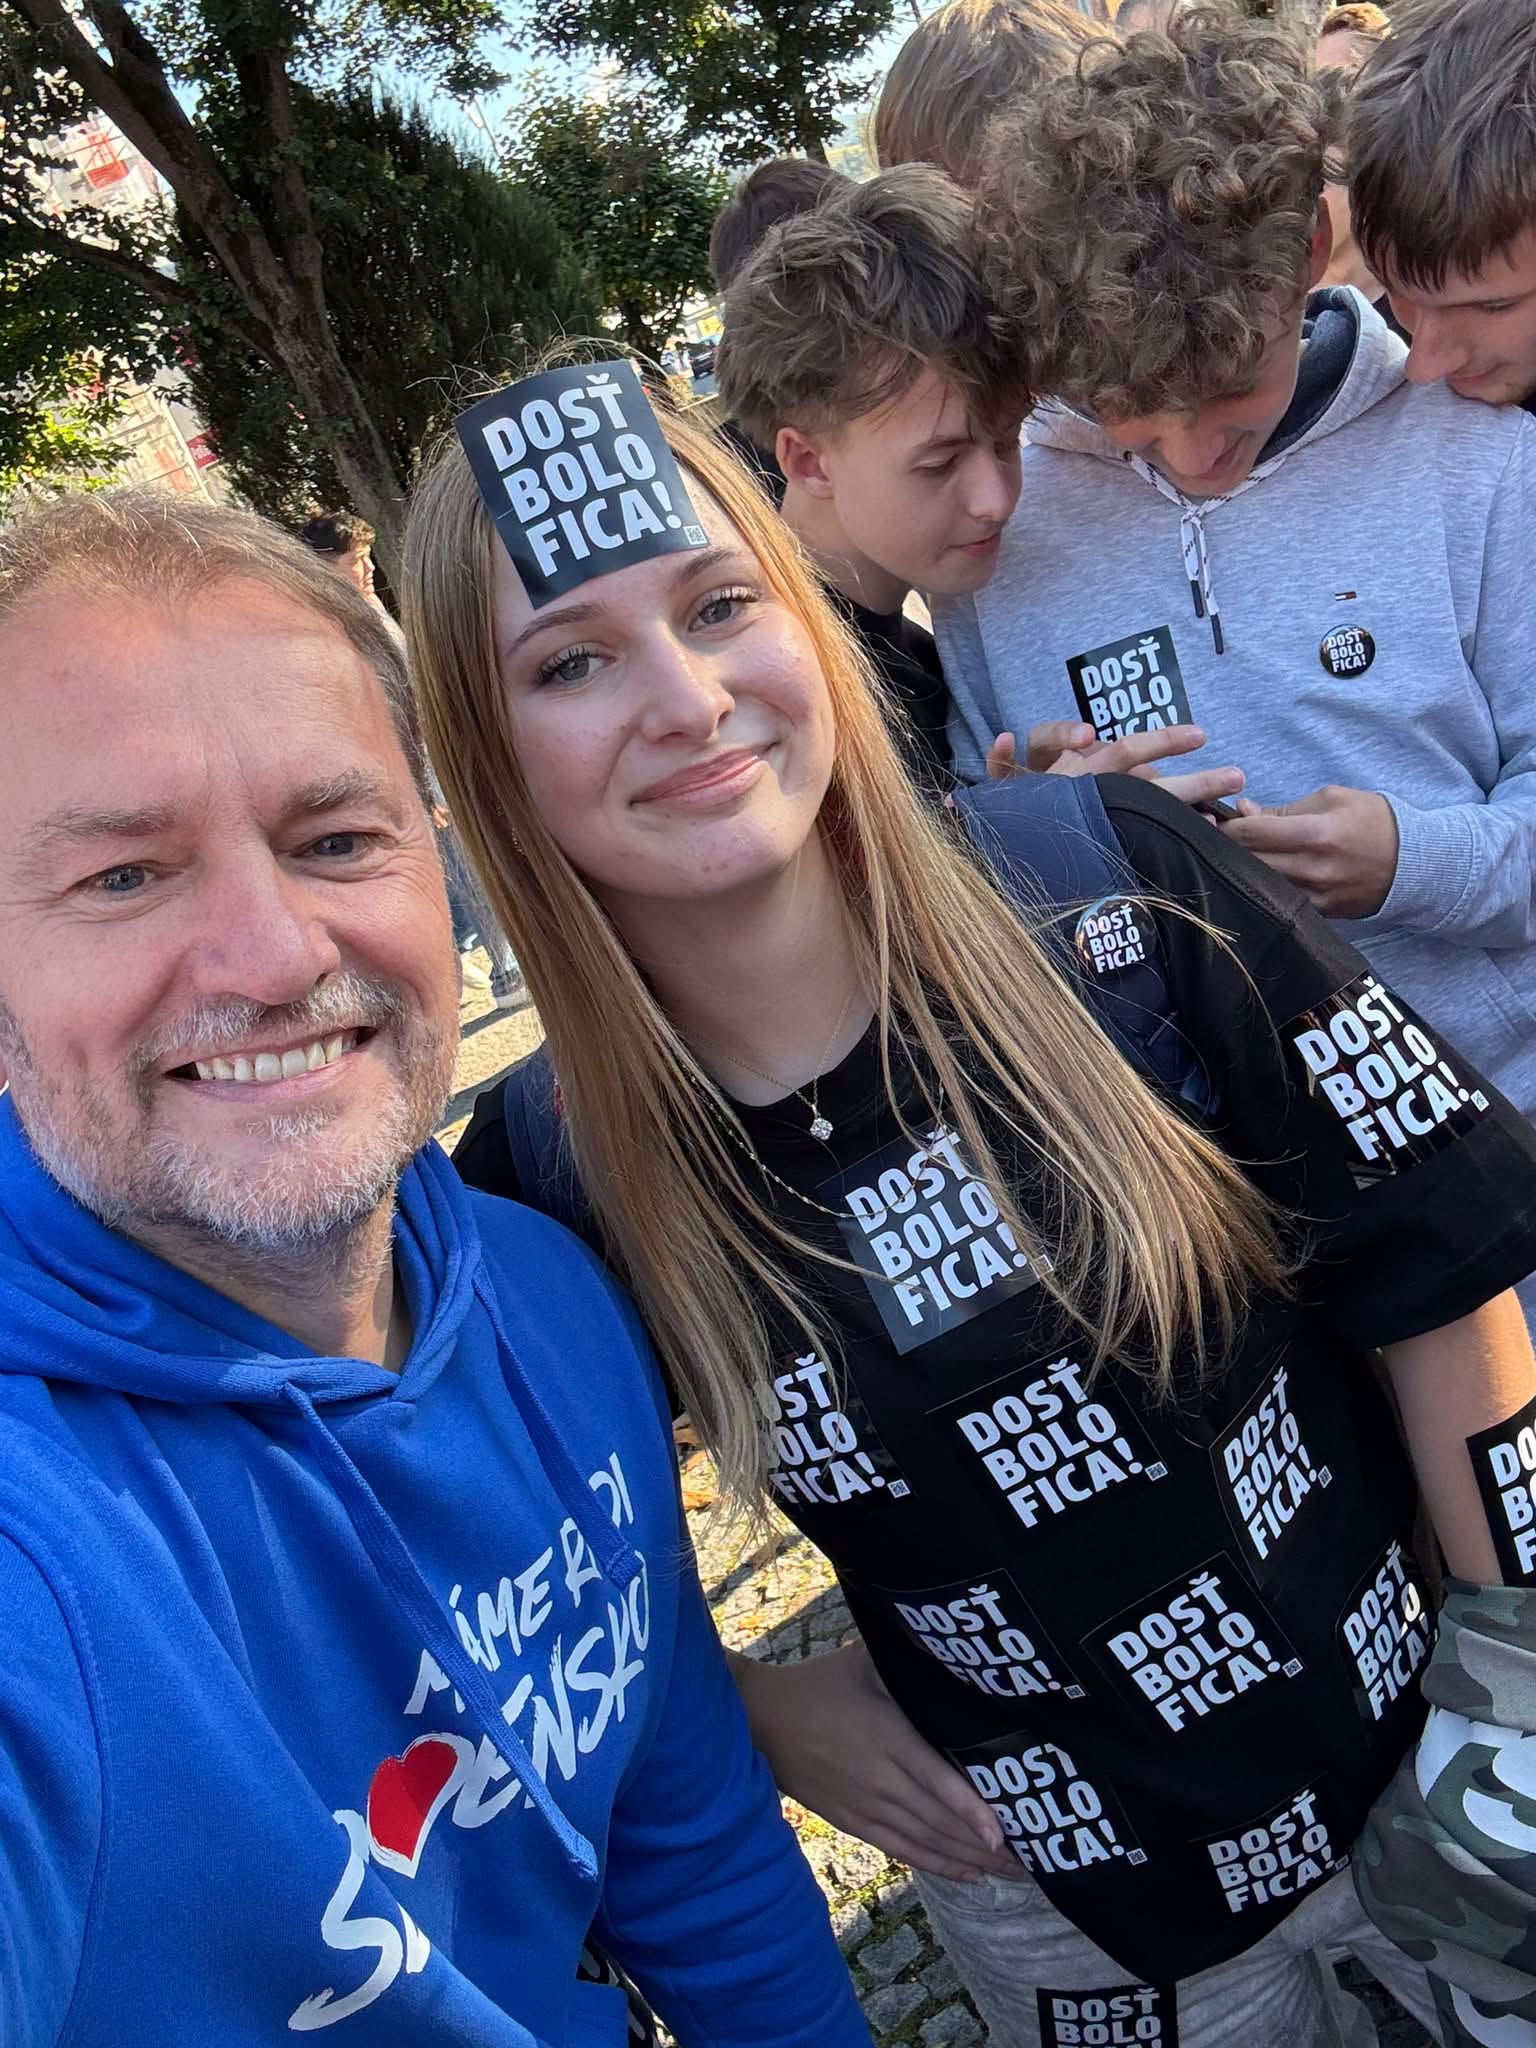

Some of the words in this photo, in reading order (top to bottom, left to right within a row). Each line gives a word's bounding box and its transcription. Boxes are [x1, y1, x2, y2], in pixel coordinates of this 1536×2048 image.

[482, 373, 628, 472] DOSŤ
[502, 433, 656, 523] BOLO
[525, 481, 682, 577] FICA!
[1080, 636, 1160, 697] DOSŤ
[1328, 628, 1361, 648] DOSŤ
[1330, 642, 1364, 660] BOLO
[1332, 654, 1367, 673] FICA!
[1089, 675, 1172, 728] BOLO
[1085, 902, 1133, 938] DOSŤ
[1089, 926, 1140, 956] BOLO
[1094, 942, 1146, 973] FICA!
[1293, 976, 1404, 1076] DOSŤ
[1320, 1024, 1437, 1118] BOLO
[1346, 1061, 1470, 1161] FICA!
[870, 1181, 999, 1279] BOLO
[893, 1222, 1028, 1327] FICA!
[774, 1411, 857, 1466] OLO
[956, 1357, 1088, 1453] DOSŤ
[982, 1403, 1117, 1491] BOLO
[1224, 1366, 1288, 1484] DOSŤ
[769, 1452, 886, 1503] FICA!
[1007, 1438, 1144, 1528] FICA!
[1233, 1413, 1299, 1522] BOLO
[1248, 1445, 1318, 1560] FICA!
[894, 1584, 1008, 1635] DOSŤ
[1107, 1571, 1229, 1671] DOSŤ
[1343, 1540, 1405, 1656] DOSŤ
[1357, 1582, 1421, 1689] BOLO
[919, 1629, 1036, 1666] BOLO
[1131, 1612, 1256, 1702] BOLO
[1155, 1640, 1281, 1733] FICA!
[990, 1780, 1102, 1837] BOLO
[1208, 1789, 1316, 1865] DOSŤ
[1216, 1824, 1328, 1889] BOLO
[1225, 1845, 1335, 1913] FICA!
[1052, 1988, 1160, 2021] DOSŤ
[1054, 2015, 1162, 2044] BOLO
